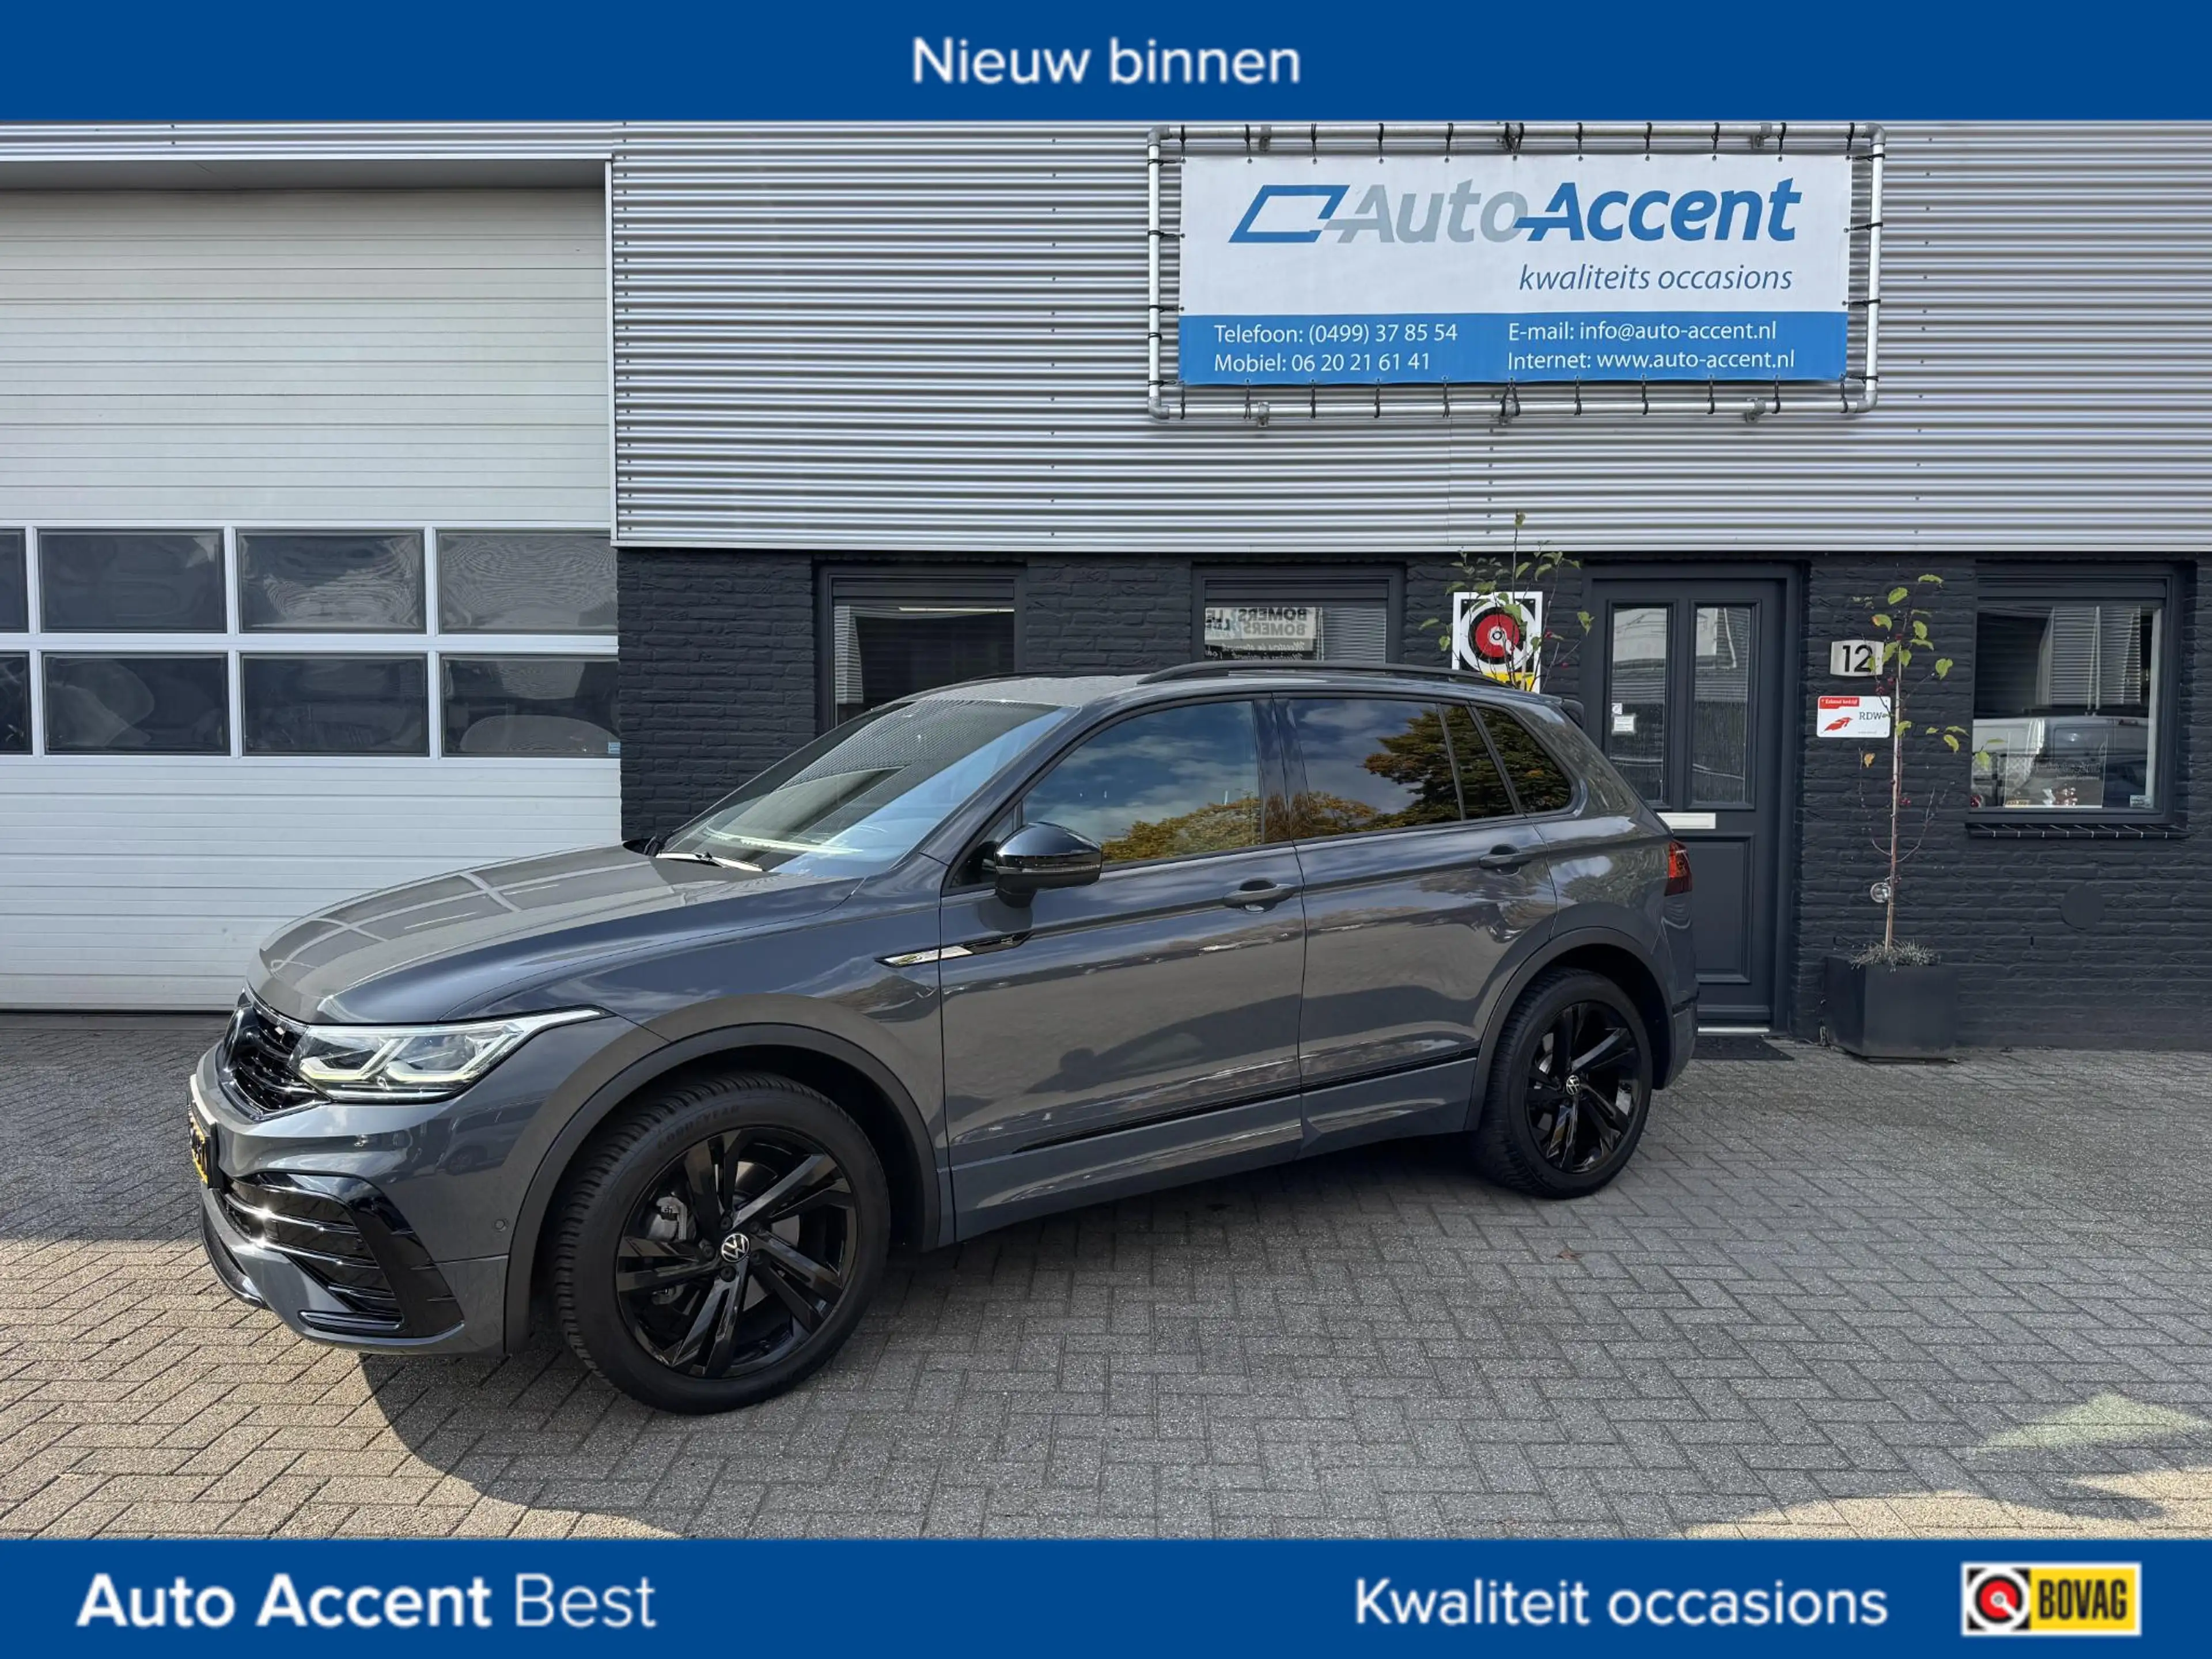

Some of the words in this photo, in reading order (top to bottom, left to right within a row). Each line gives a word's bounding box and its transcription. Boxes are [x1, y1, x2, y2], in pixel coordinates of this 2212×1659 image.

[1519, 263, 1650, 290] kwaliteits
[1658, 264, 1793, 290] occasions
[1214, 324, 1303, 343] Telefoon:
[1309, 324, 1369, 345] (0499)
[1376, 324, 1399, 342] 37
[1404, 324, 1427, 341] 85
[1434, 324, 1457, 341] 54
[1509, 321, 1574, 340] E-mail:
[1580, 320, 1776, 341] info@auto-accent.nl
[1214, 353, 1286, 372] Mobiel:
[1291, 354, 1315, 372] 06
[1321, 354, 1344, 372] 20
[1350, 354, 1370, 370] 21
[1379, 353, 1399, 370] 61
[1408, 353, 1428, 369] 41
[1508, 351, 1591, 370] Internet:
[1597, 350, 1794, 369] www.auto-accent.nl
[1843, 645, 1873, 672] 12
[1859, 711, 1881, 720] RDW
